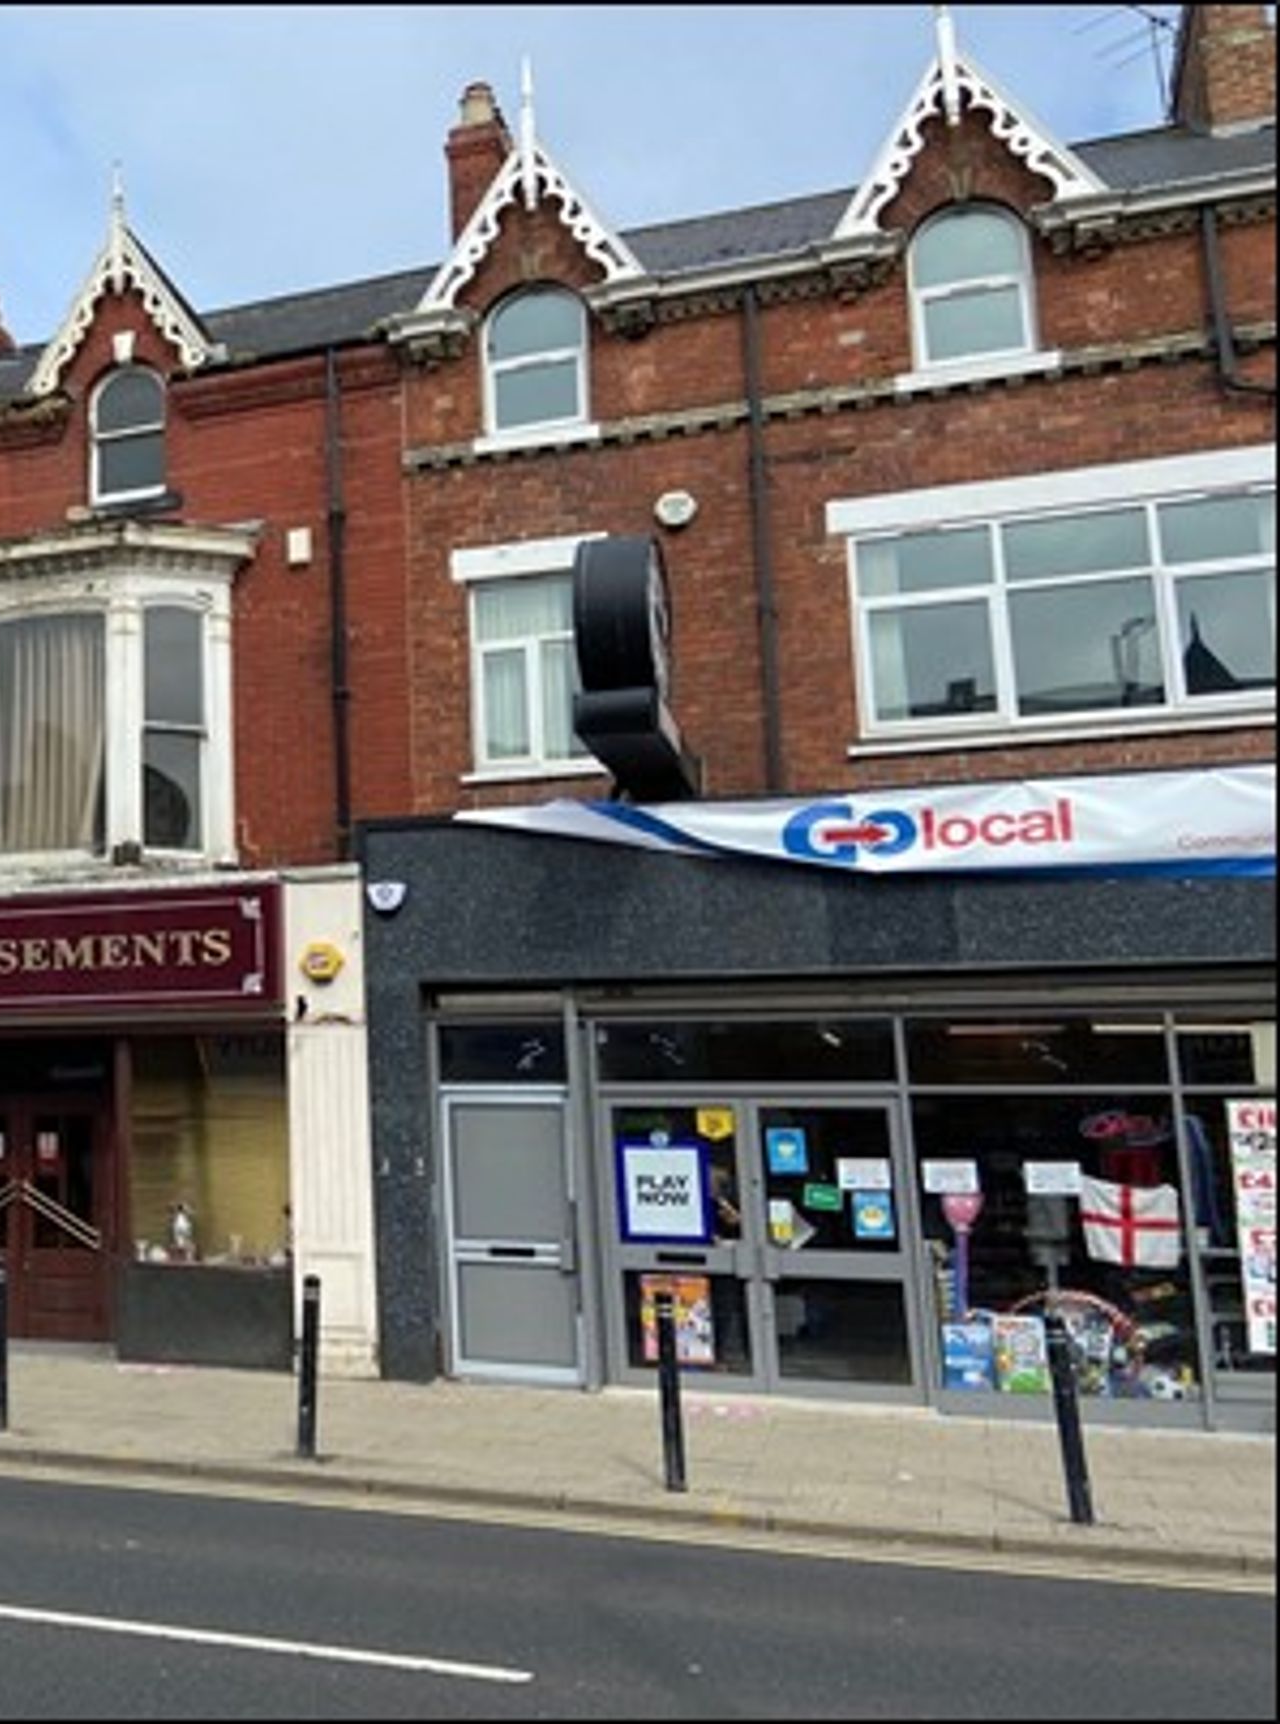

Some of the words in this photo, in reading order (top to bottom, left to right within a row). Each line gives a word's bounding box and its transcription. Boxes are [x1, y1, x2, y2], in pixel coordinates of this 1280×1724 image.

[922, 799, 1072, 849] local
[636, 1175, 689, 1189] PLAY
[637, 1192, 690, 1206] NOW
